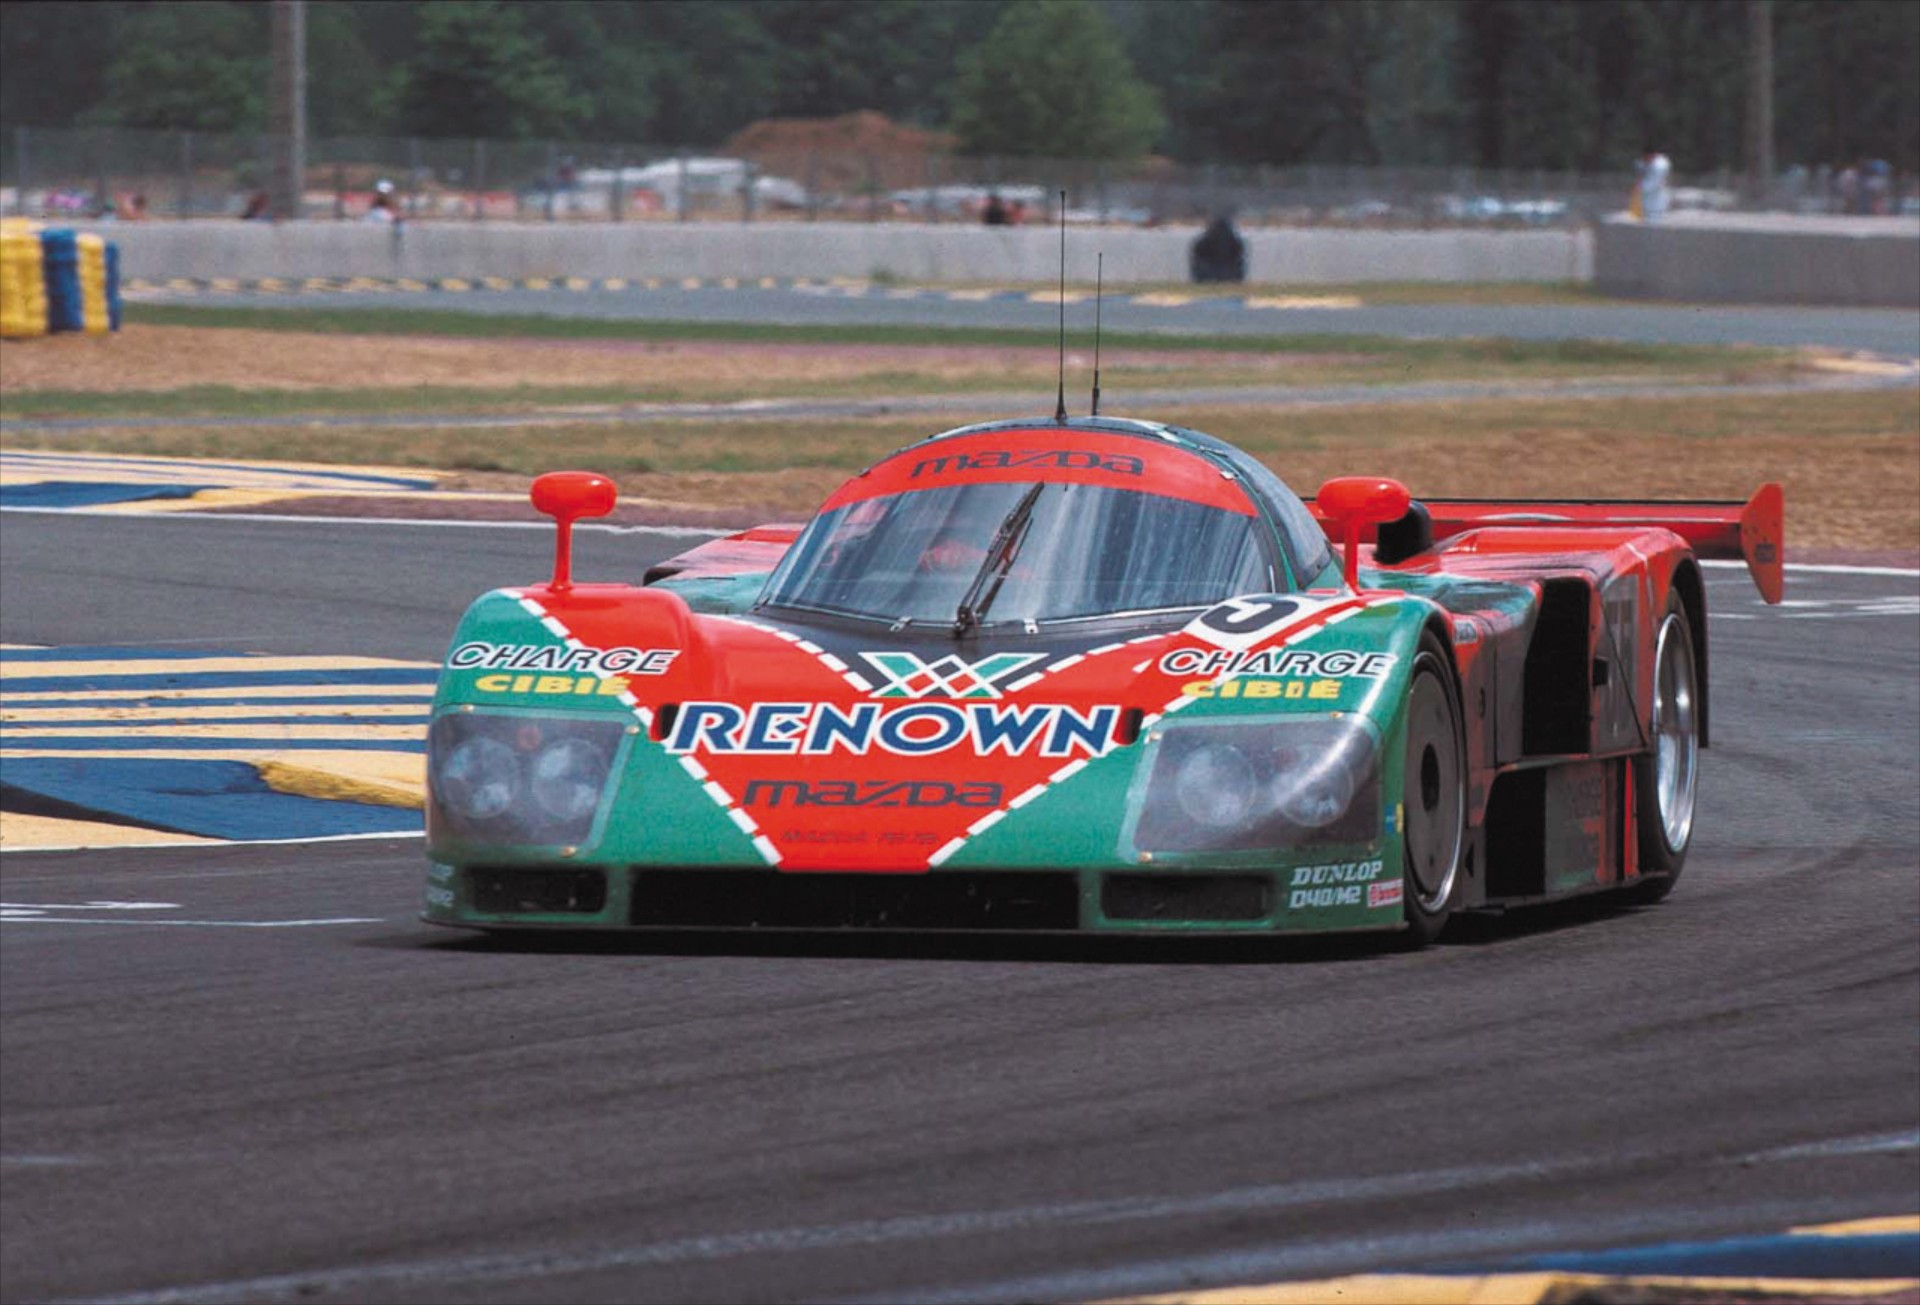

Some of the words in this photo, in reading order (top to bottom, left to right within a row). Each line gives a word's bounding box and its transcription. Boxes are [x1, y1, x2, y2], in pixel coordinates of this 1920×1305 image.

[449, 642, 679, 674] CHARGE
[1160, 648, 1394, 678] CHARGE
[669, 703, 1118, 755] RENOWN
[1290, 860, 1383, 885] DUNLOP
